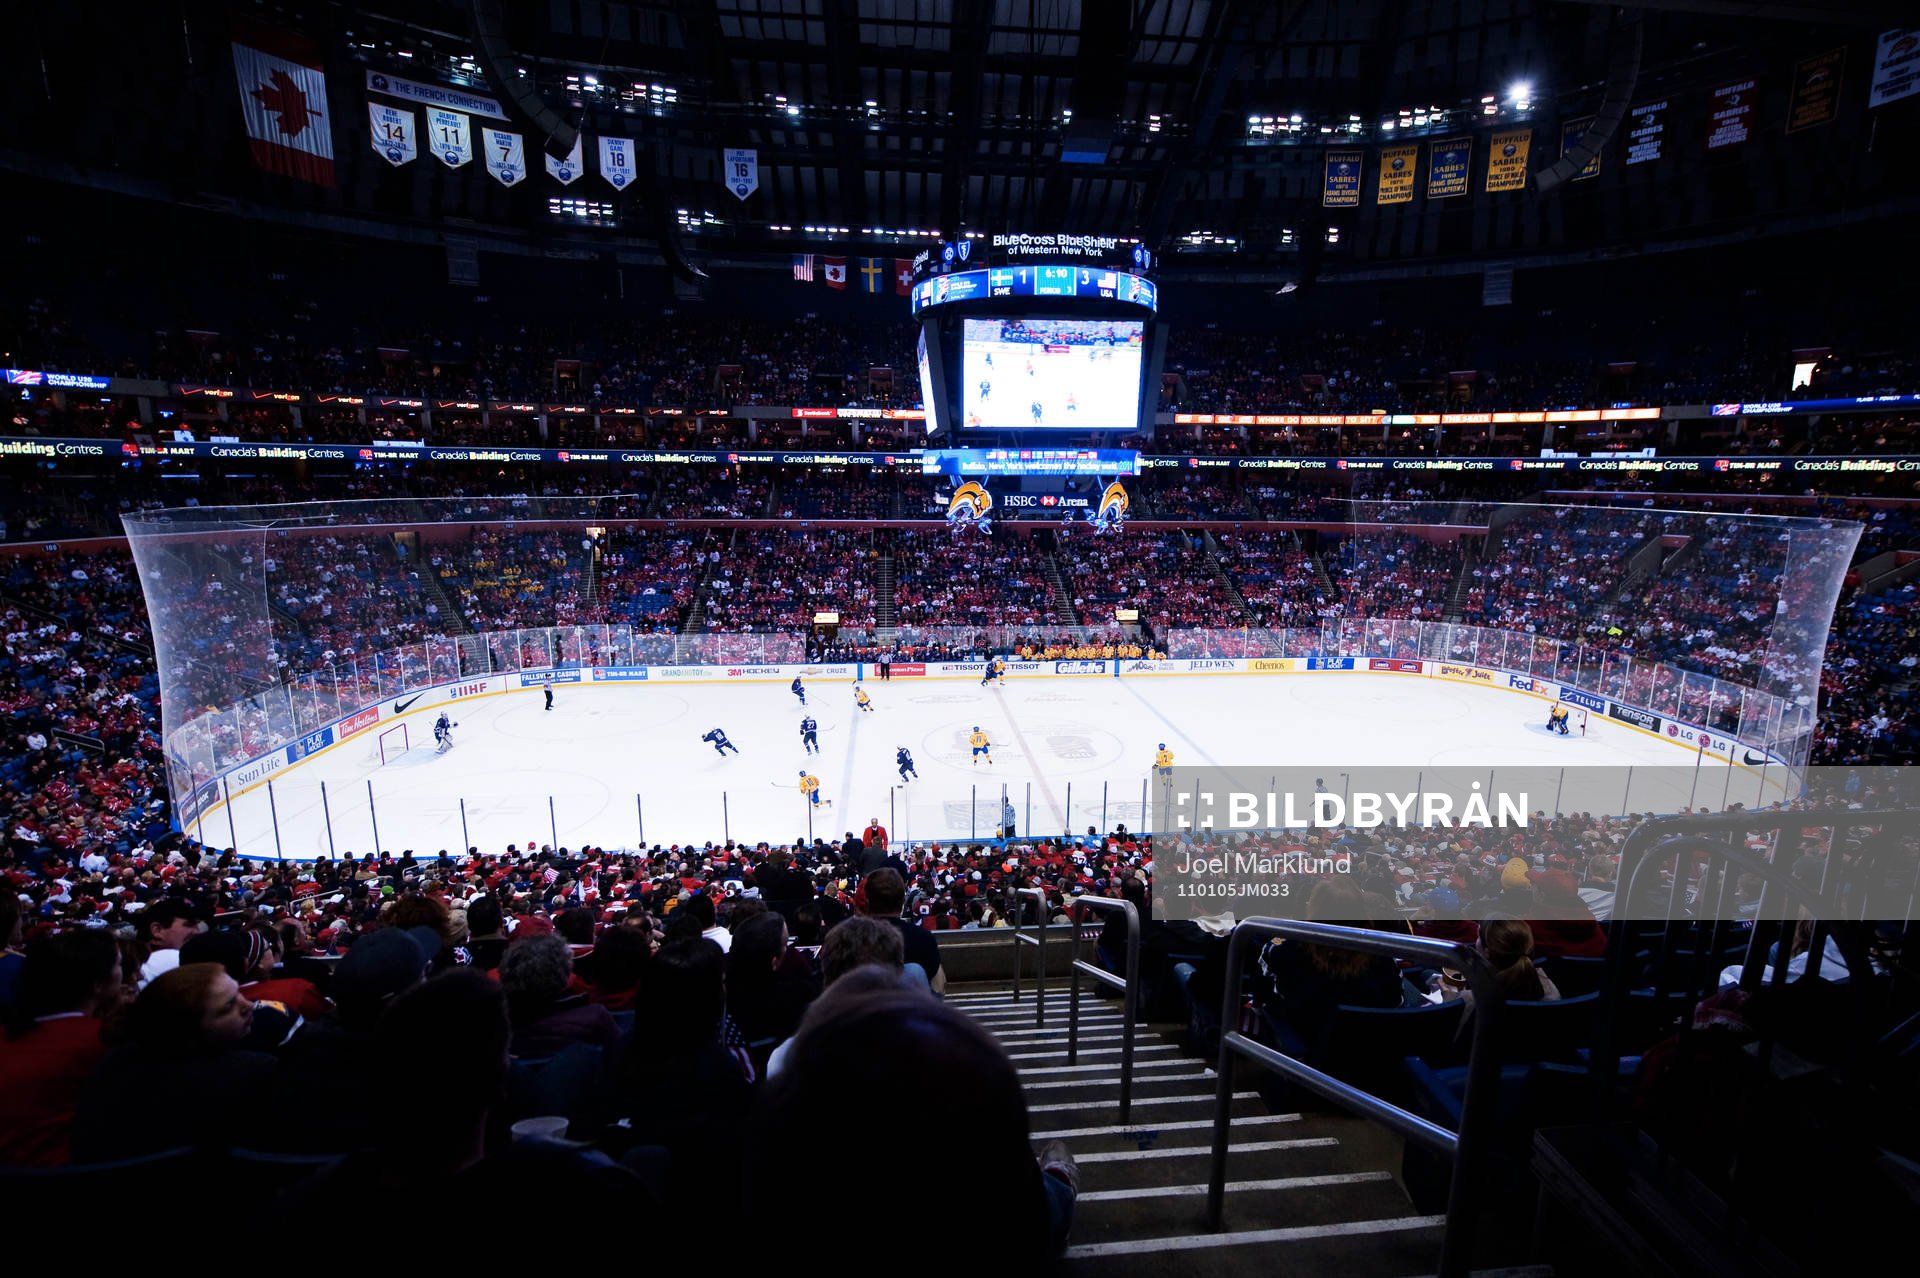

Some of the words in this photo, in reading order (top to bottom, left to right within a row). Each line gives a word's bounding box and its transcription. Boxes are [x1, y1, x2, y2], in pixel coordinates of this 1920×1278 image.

[1714, 80, 1755, 97] BUFFALO
[395, 81, 411, 95] THE
[414, 85, 445, 102] FRENCH
[448, 93, 497, 113] CONNECTION
[1631, 101, 1668, 117] BUFFALO
[1713, 104, 1750, 120] SABRES
[383, 123, 405, 142] 14
[440, 127, 460, 145] 11
[1630, 123, 1664, 139] SABRES
[1493, 135, 1530, 145] BUFFALO
[1383, 149, 1416, 158] BUFFALO
[1433, 143, 1469, 153] BUFFALO
[499, 146, 510, 162] 7
[610, 152, 625, 167] 18
[1493, 157, 1525, 167] SABRES
[735, 163, 748, 177] 16
[1434, 164, 1465, 174] SABRES
[1383, 171, 1412, 179] SABRES
[1488, 180, 1523, 188] CHAMPIONS
[993, 234, 1055, 247] BlueCross
[1057, 234, 1115, 249] BlueShield
[1008, 246, 1017, 255] of
[1019, 246, 1058, 255] Western
[1061, 246, 1081, 255] New
[1081, 247, 1103, 257] York
[1019, 270, 1027, 284] 1
[1081, 270, 1090, 285] 3
[994, 288, 1011, 296] SWE
[1100, 289, 1113, 298] USA
[47, 374, 76, 382] WORLD
[47, 379, 107, 389] CHAMPIONSHIP
[204, 389, 233, 397] verizon
[273, 393, 300, 401] verizon
[1258, 416, 1285, 424] WHERE
[1287, 416, 1300, 424] DO
[1301, 416, 1319, 424] YOU
[1319, 416, 1342, 424] WANT
[1345, 416, 1357, 424] TO
[56, 443, 103, 455] Centres
[171, 447, 194, 455] MART
[211, 446, 257, 457] Canada's
[258, 448, 307, 460] Building
[308, 448, 344, 458] Centres
[430, 451, 469, 460] Canada's
[470, 452, 510, 461] Building
[511, 452, 541, 460] Centres
[622, 453, 654, 462] Canada's
[655, 454, 690, 463] Building
[690, 454, 717, 463] Centres
[783, 455, 813, 463] Canada's
[814, 456, 848, 465] Building
[848, 456, 874, 464] Centres
[1063, 462, 1076, 470] the
[1155, 459, 1179, 467] Centres
[1238, 460, 1267, 468] Canada's
[1268, 460, 1300, 469] Building
[1301, 460, 1326, 468] Centres
[1393, 460, 1425, 469] Canada's
[1426, 461, 1463, 471] Building
[1463, 460, 1493, 469] Centres
[1579, 461, 1617, 470] Canada's
[1618, 461, 1664, 471] Building
[1664, 461, 1699, 470] Centres
[1794, 460, 1839, 470] Canada's
[1840, 461, 1896, 472] Building
[1004, 495, 1037, 506] HSBC
[1058, 495, 1088, 507] Arena
[1057, 662, 1104, 673] Gillette
[1255, 660, 1285, 670] Cheerios
[557, 670, 580, 678] CASINO
[728, 669, 742, 677] 3M
[1472, 670, 1491, 680] Juice
[458, 683, 488, 696] IIHF
[1510, 675, 1548, 696] FedEx
[1576, 694, 1600, 709] TELUS
[1616, 706, 1654, 724] TENSOR
[341, 724, 354, 737] Tim
[354, 713, 378, 729] Hortons
[807, 721, 815, 729] 27
[307, 733, 323, 747] PLAY
[1681, 729, 1693, 740] LG
[1713, 740, 1726, 751] LG
[237, 770, 260, 786] Sun
[261, 757, 280, 773] Life
